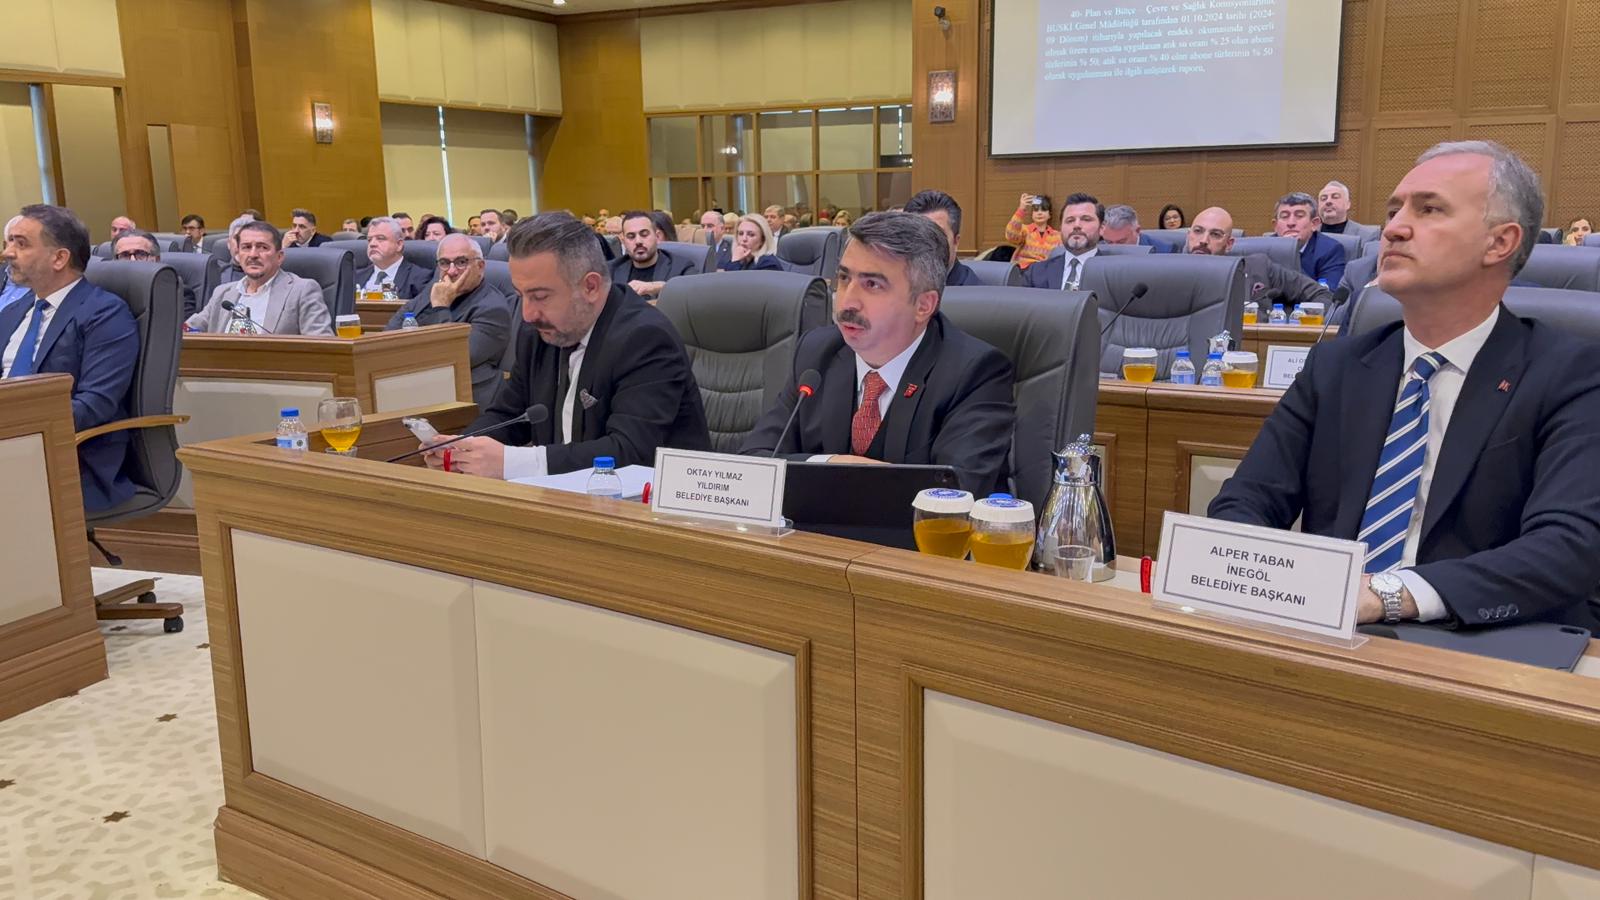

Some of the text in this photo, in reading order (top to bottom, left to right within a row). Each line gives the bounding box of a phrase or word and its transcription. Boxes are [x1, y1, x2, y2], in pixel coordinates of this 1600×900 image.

[1085, 8, 1101, 17] Plan
[1145, 4, 1168, 14] Çevre
[1075, 21, 1096, 31] Genel
[1142, 15, 1179, 26] tarafından
[1168, 26, 1193, 37] endeks
[686, 467, 743, 481] OKTAY YILMAZ
[697, 481, 730, 492] YILDIRIM
[675, 491, 750, 507] BELEDİYE BAŞKANI
[1210, 546, 1295, 569] ALPER TABAN
[1226, 562, 1271, 583] İNEGÖL
[1191, 574, 1306, 606] BELEDİYE BAŞKANI
